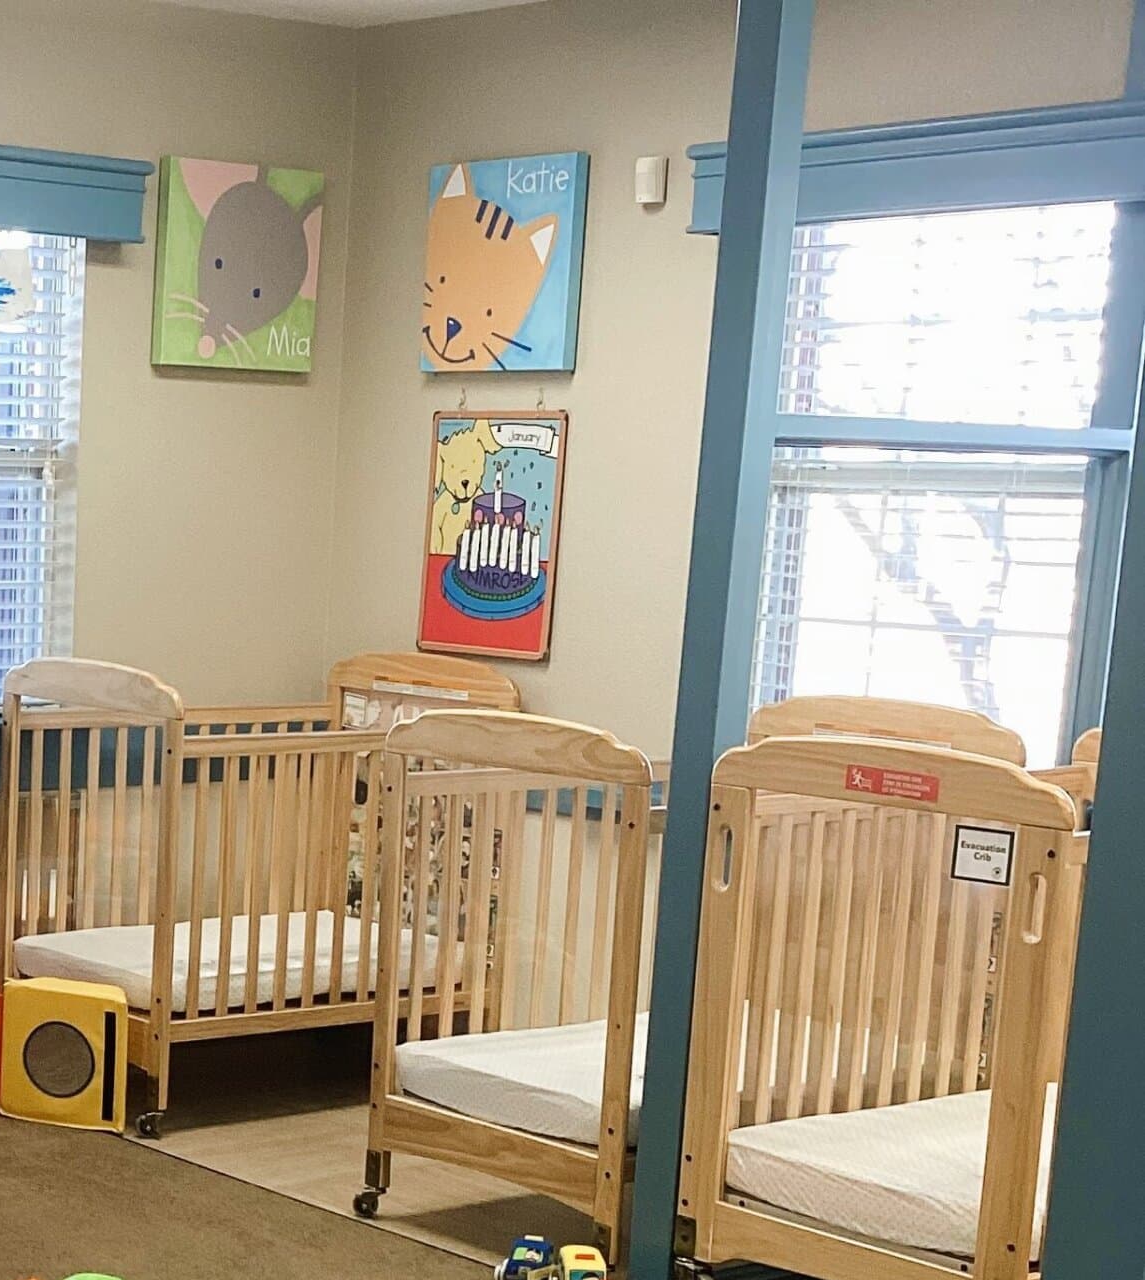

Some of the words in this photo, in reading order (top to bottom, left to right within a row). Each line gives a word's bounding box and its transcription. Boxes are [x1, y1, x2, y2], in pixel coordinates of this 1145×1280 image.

[506, 160, 570, 199] Katie
[266, 323, 311, 357] Mia
[960, 840, 1007, 854] Evacuation
[973, 851, 992, 862] Crib
